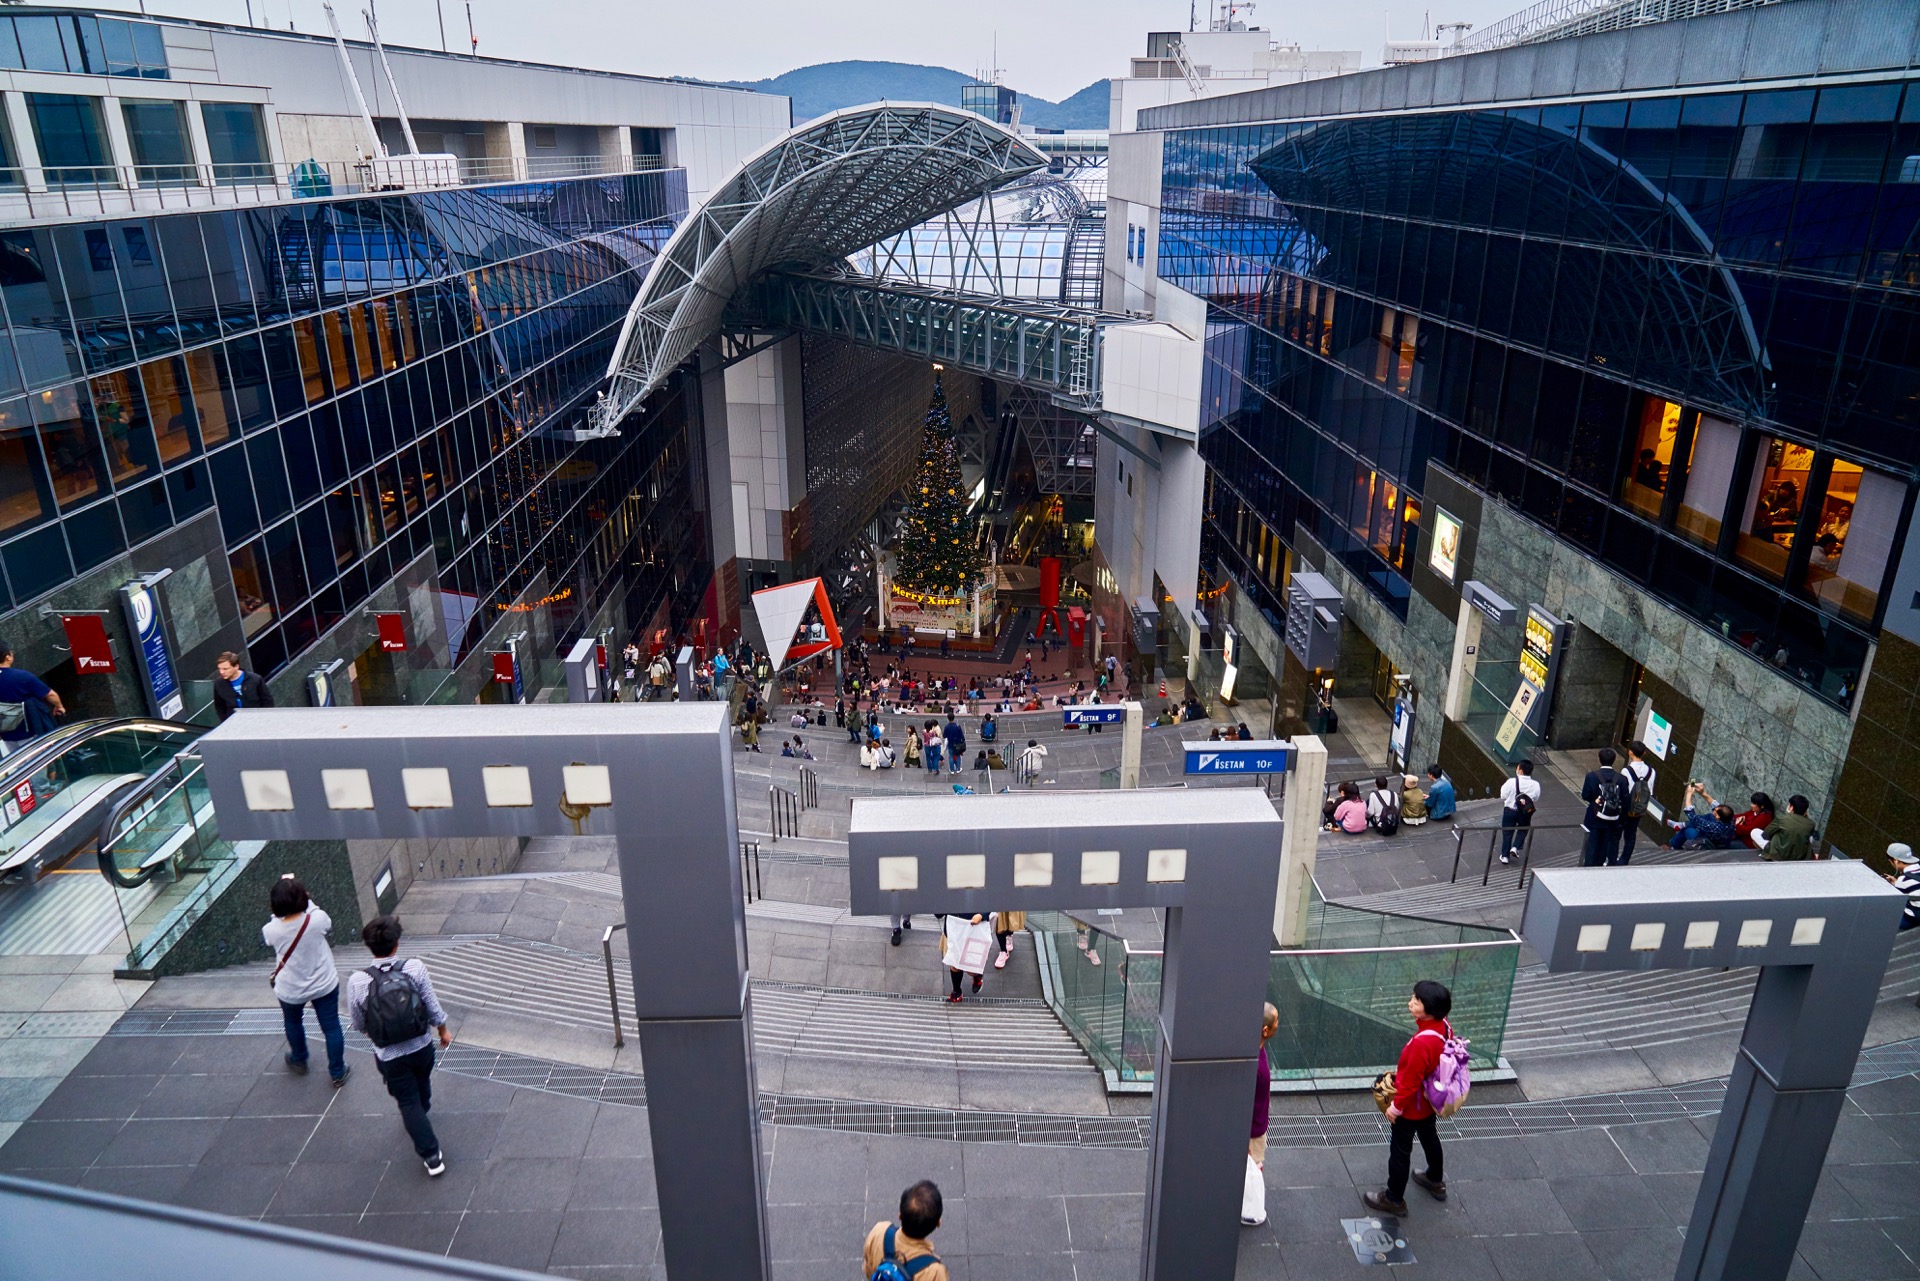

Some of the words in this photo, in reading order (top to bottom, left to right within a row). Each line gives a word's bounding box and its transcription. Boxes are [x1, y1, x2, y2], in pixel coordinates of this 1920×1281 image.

[892, 584, 925, 603] Merry
[927, 596, 961, 605] Xmas
[1079, 714, 1099, 722] ISETAN
[1107, 713, 1117, 722] 9F
[1215, 758, 1245, 770] ISETAN
[1256, 759, 1273, 769] 10F
